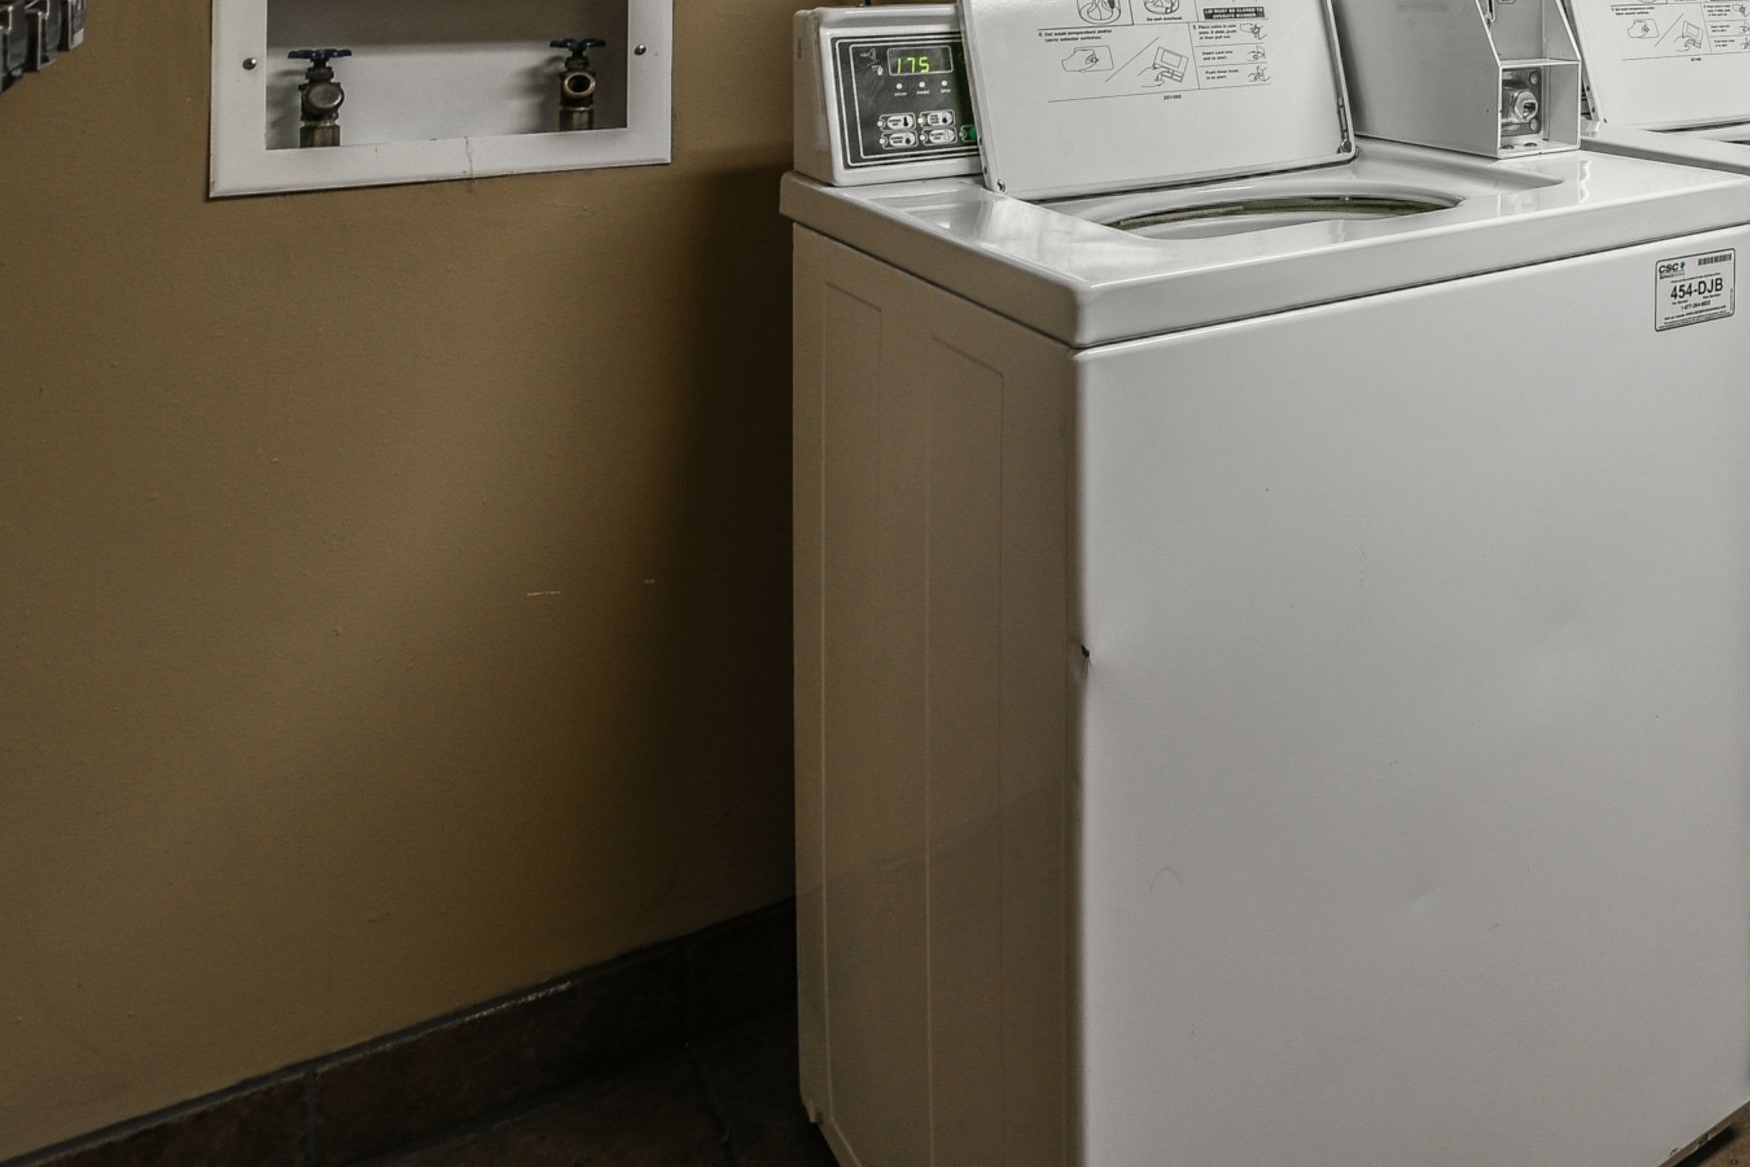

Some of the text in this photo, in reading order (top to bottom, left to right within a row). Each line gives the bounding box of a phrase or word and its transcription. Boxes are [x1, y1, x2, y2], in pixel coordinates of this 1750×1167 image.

[897, 56, 930, 74] 175
[1658, 263, 1679, 274] CSC
[1670, 277, 1723, 300] 454-DJB
